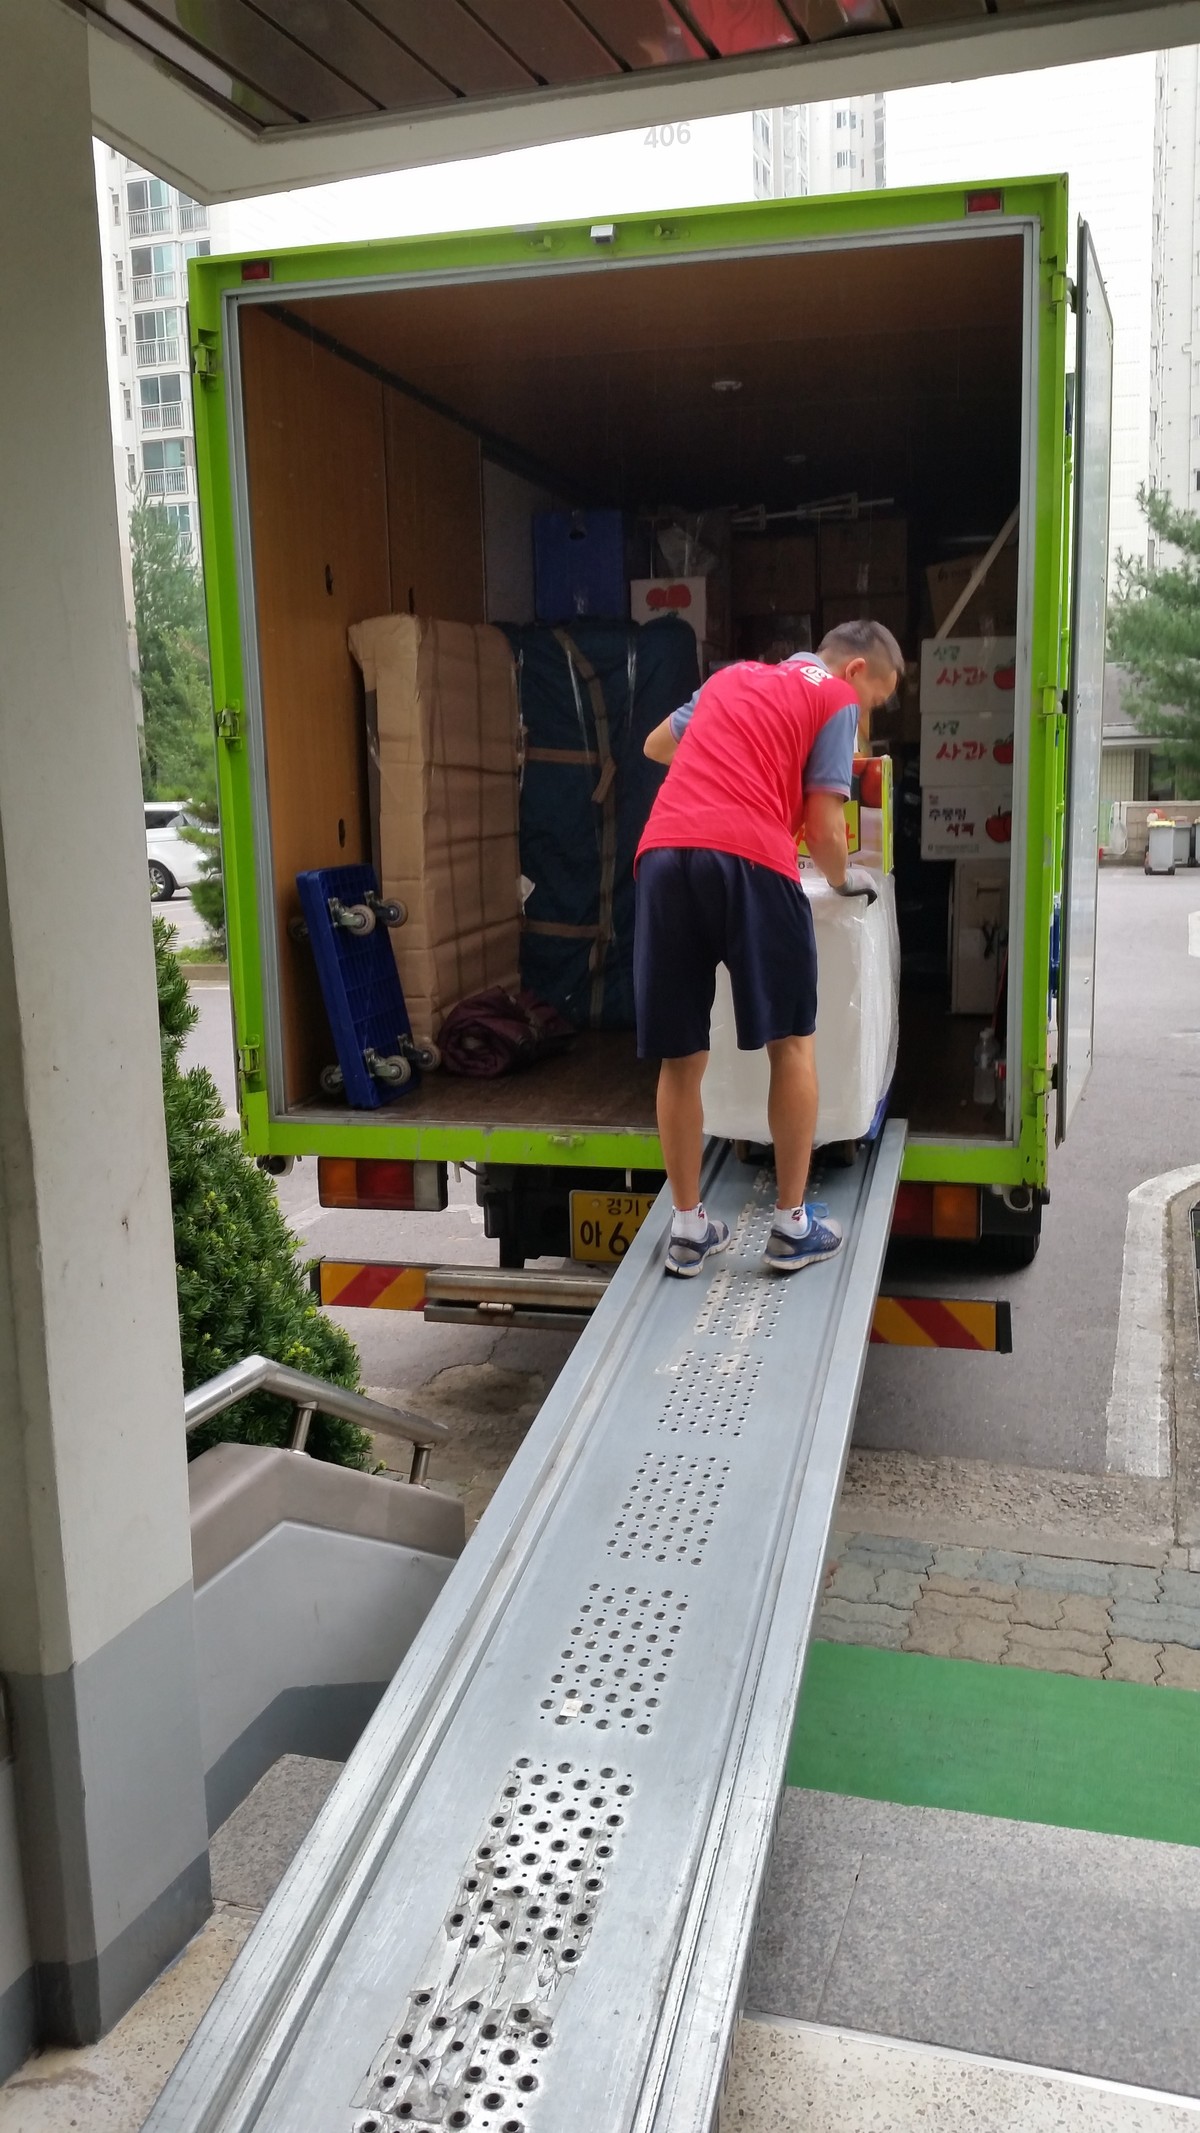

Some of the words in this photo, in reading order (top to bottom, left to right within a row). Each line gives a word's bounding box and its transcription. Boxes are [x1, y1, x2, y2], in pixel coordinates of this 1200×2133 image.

[643, 121, 691, 148] 406
[936, 666, 988, 687] 사과
[936, 740, 988, 761] 사과
[607, 1198, 639, 1217] 경기
[580, 1220, 639, 1256] 아6
